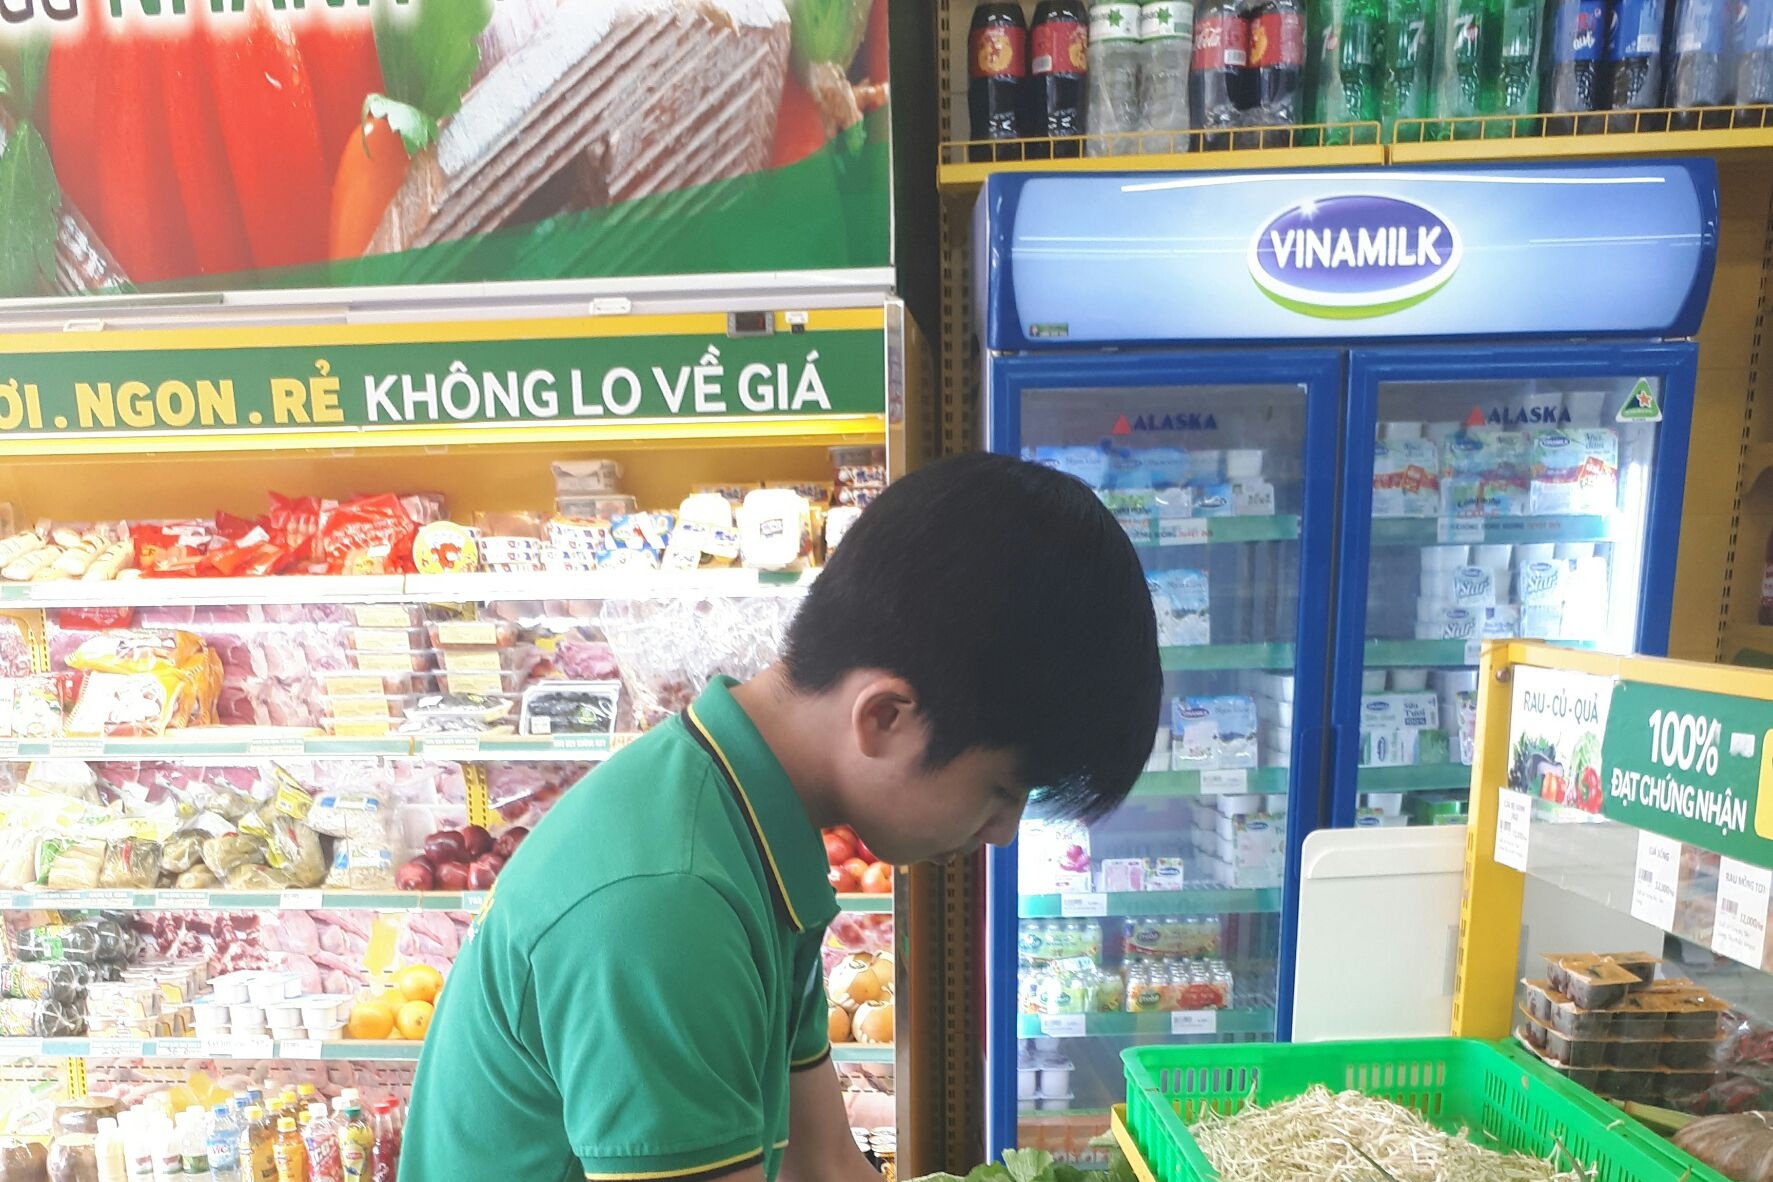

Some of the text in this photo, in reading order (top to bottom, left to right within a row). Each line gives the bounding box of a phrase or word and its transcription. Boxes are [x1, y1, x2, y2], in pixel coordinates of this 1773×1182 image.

[1270, 226, 1442, 269] VINAMILK
[74, 380, 238, 429] NGON
[270, 359, 345, 425] RẺ
[364, 360, 558, 422] KHÔNG
[571, 366, 642, 417] LO
[652, 344, 727, 414] VỀ
[738, 349, 832, 412] GIÁ
[1134, 413, 1218, 431] ALASKA
[1485, 405, 1572, 424] ALASKA
[1523, 690, 1546, 713] RAU
[1552, 687, 1568, 718] CỦ
[1574, 692, 1599, 725] QUẢ
[1649, 708, 1722, 776] 100%
[1611, 767, 1748, 836] ĐẠT CHỨNG NHẬN
